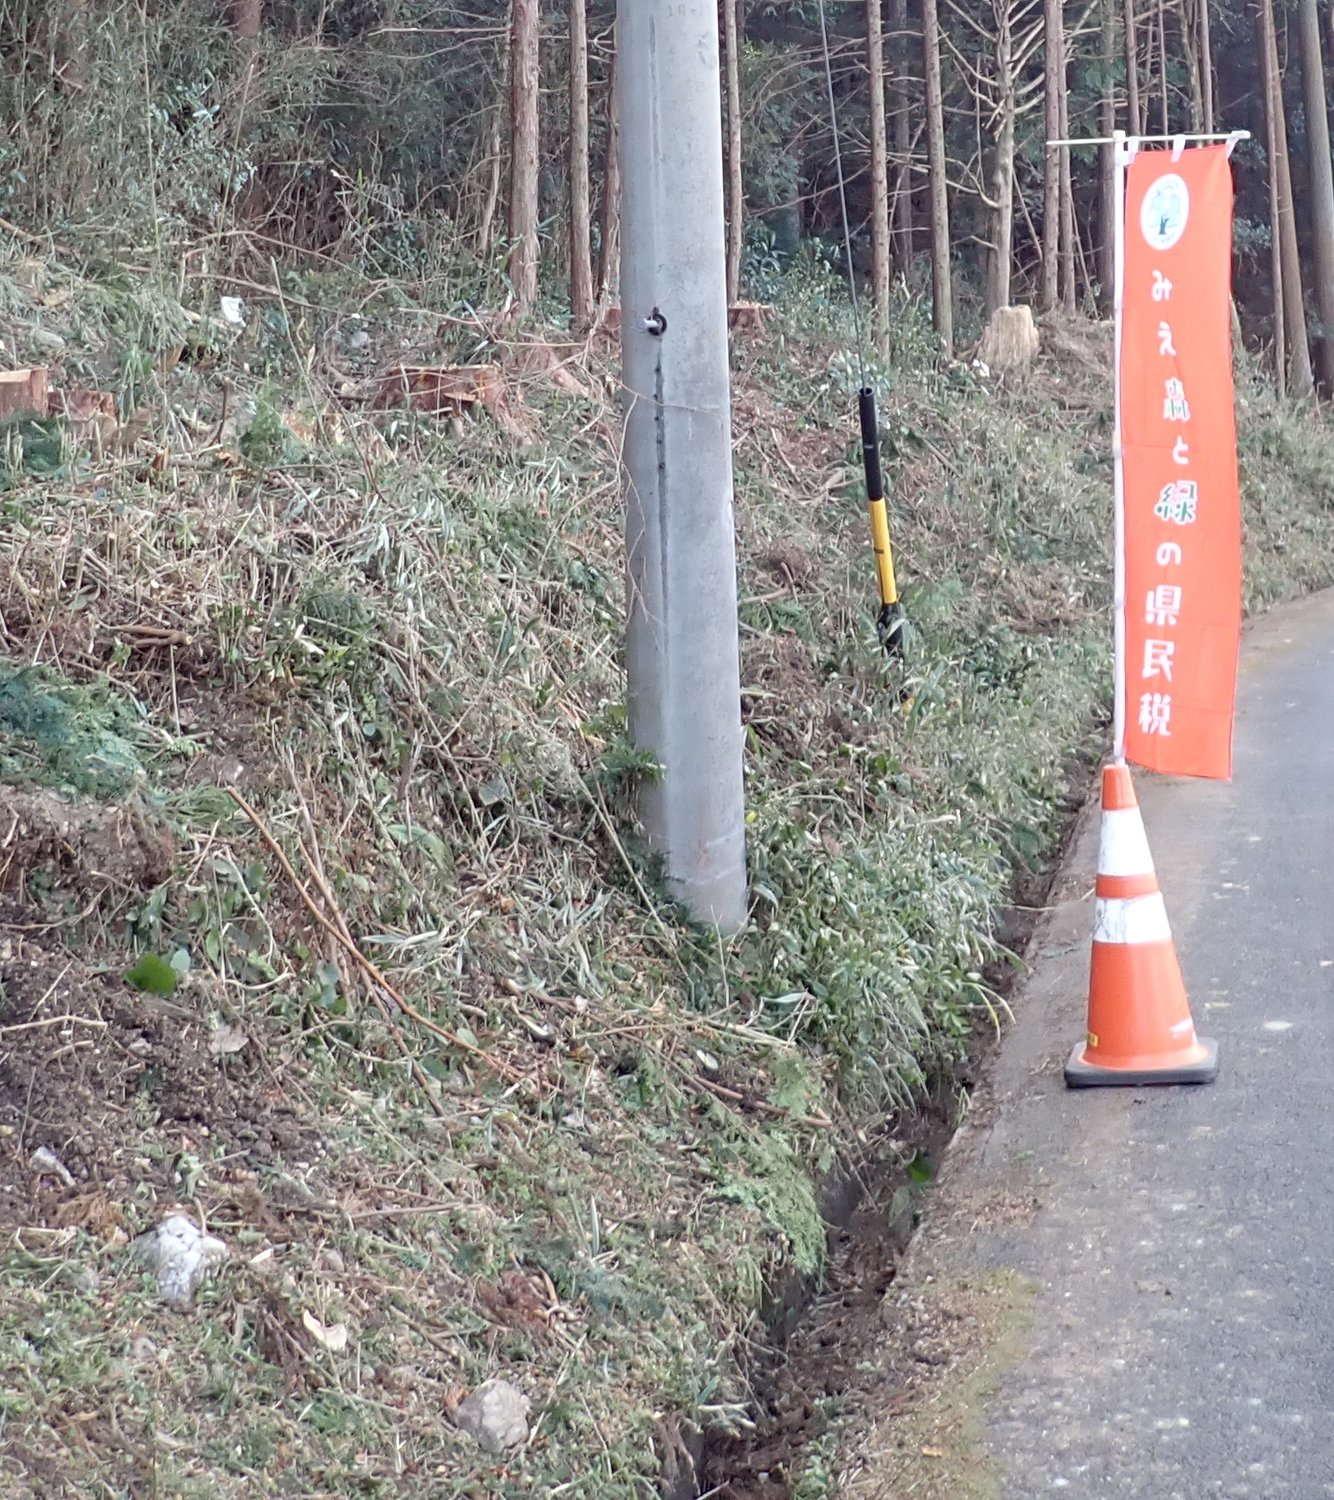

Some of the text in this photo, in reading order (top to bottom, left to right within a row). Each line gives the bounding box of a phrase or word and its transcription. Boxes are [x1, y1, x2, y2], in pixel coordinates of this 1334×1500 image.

[1138, 269, 1198, 736] みえ森と緑の県民税
